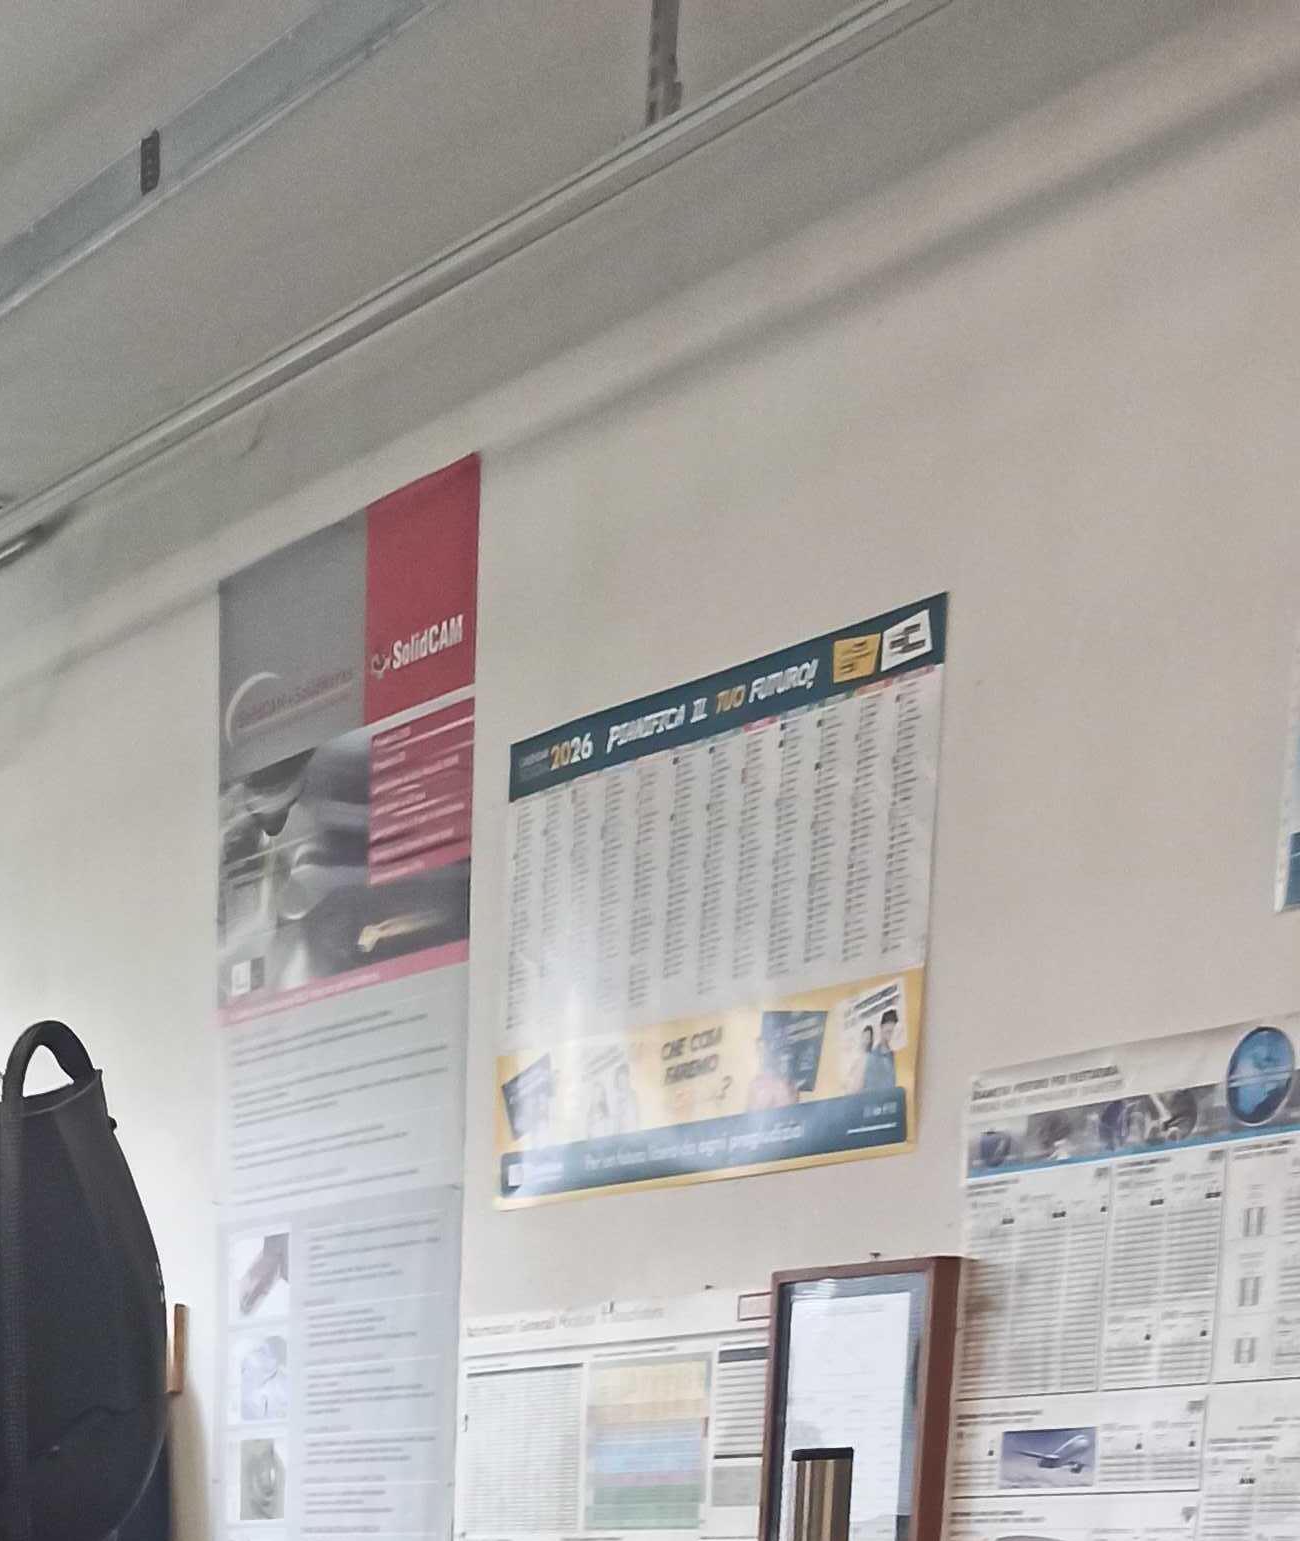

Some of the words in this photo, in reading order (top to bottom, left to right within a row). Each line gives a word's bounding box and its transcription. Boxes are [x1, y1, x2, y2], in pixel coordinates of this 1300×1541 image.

[392, 614, 464, 670] SolidCAM
[550, 732, 594, 770] 2026
[716, 685, 746, 714] TUO
[748, 658, 819, 703] FUTURO!
